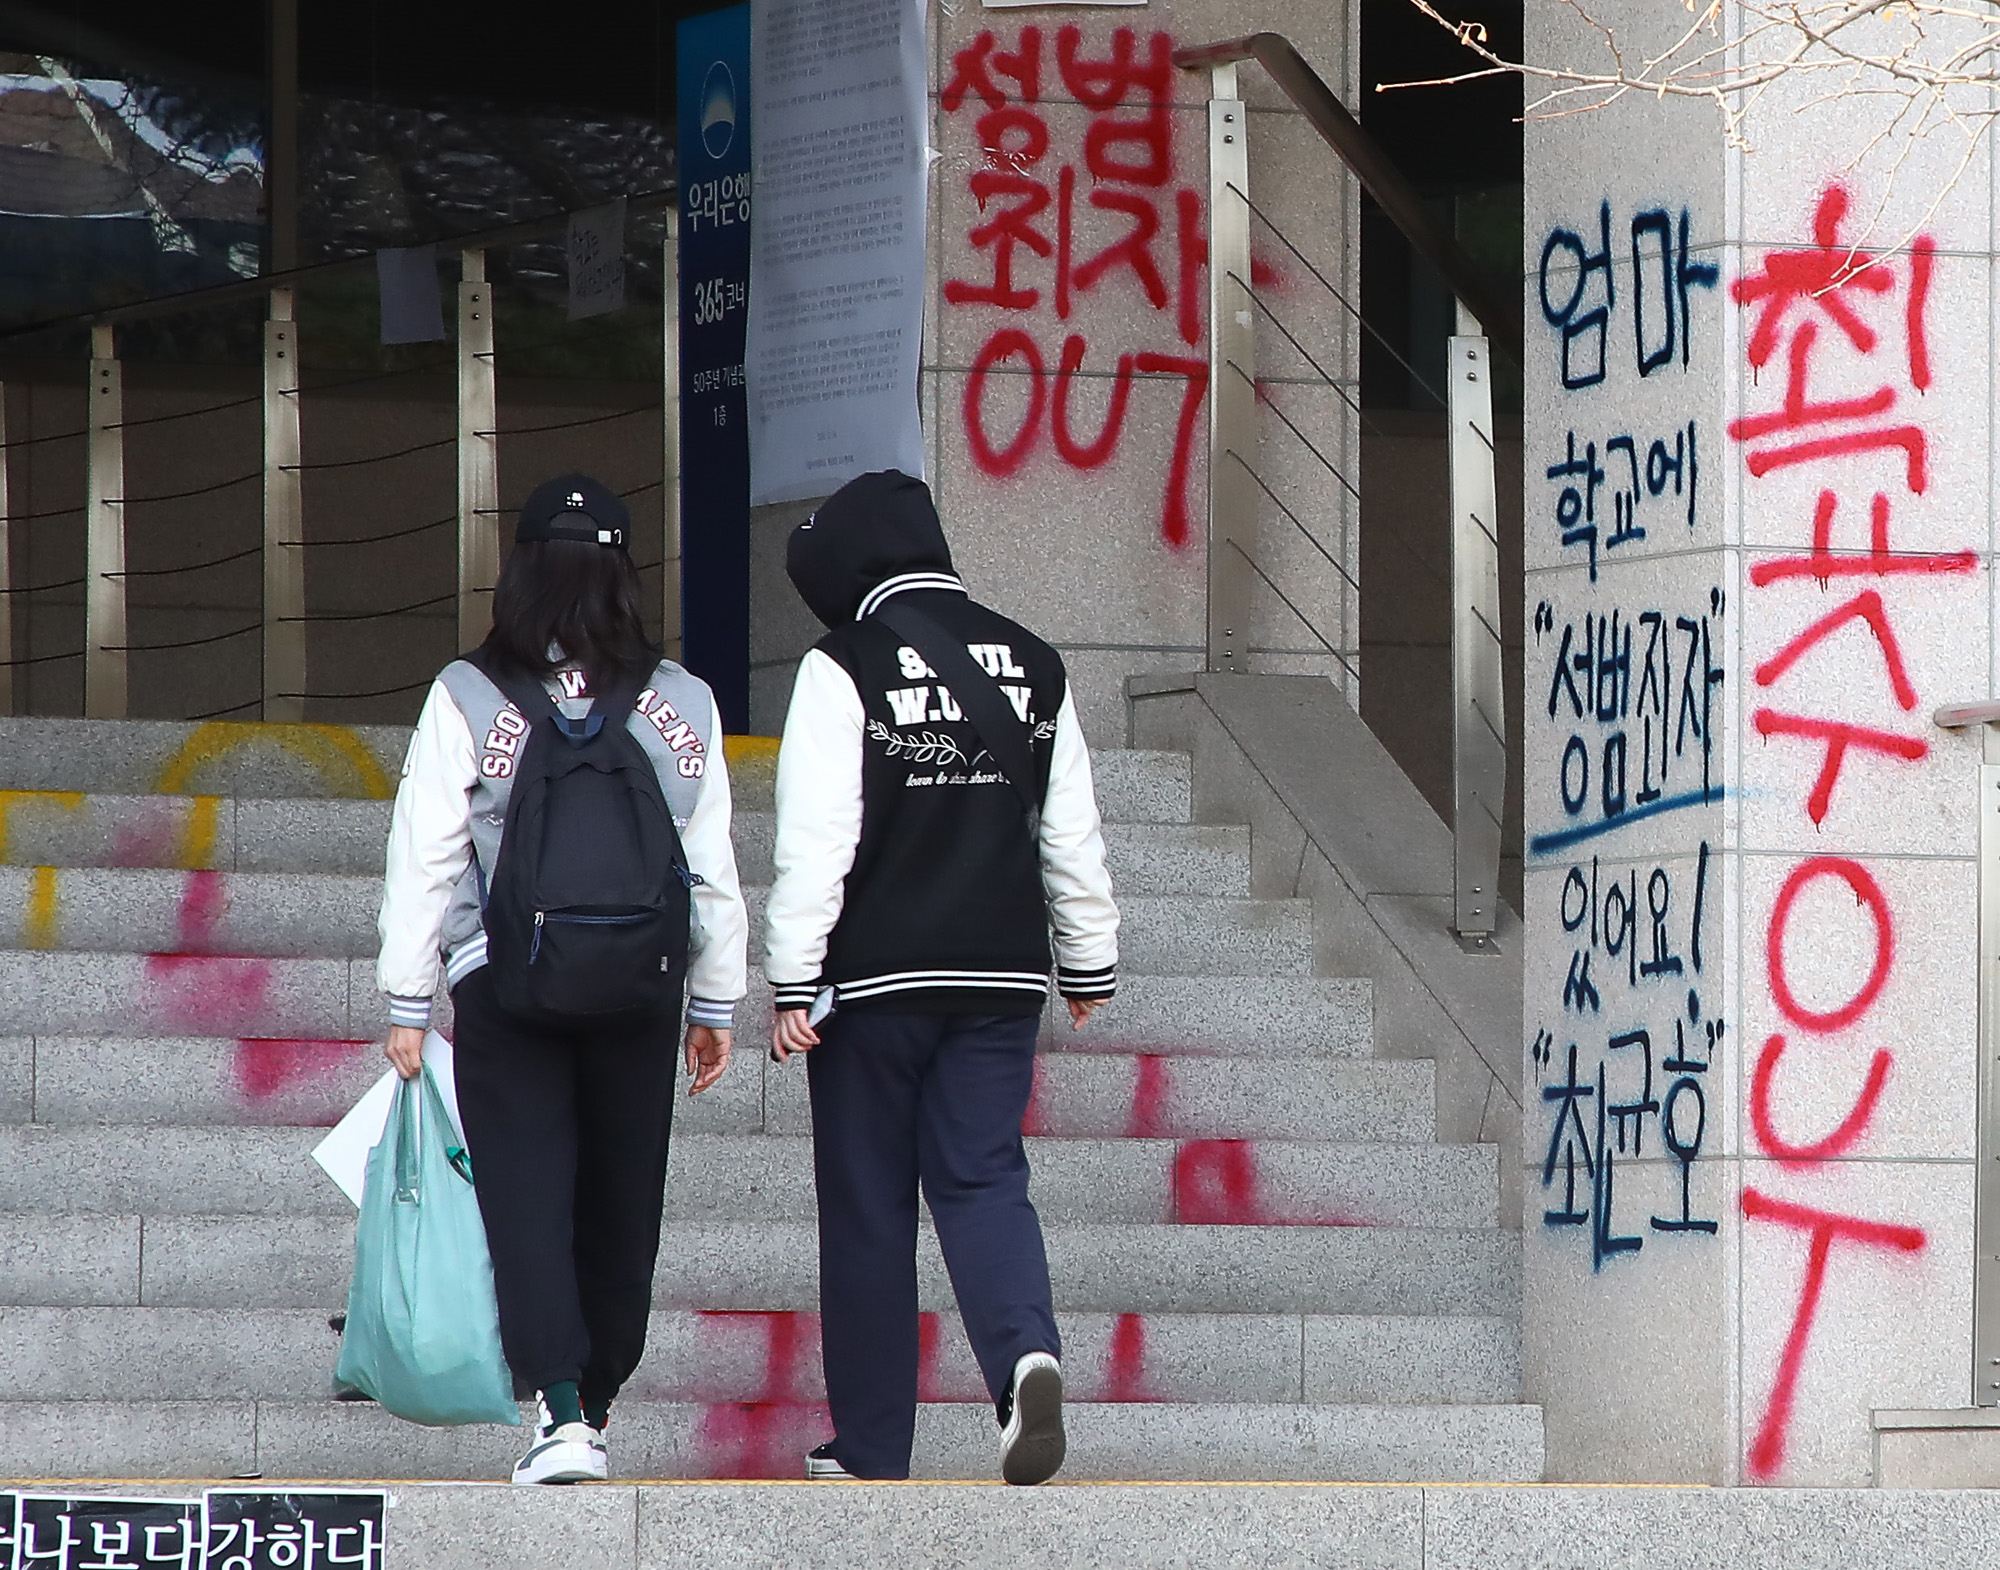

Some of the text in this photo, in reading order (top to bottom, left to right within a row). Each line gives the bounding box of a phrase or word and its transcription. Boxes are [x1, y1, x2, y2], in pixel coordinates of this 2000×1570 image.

[942, 26, 1172, 188] 성범
[687, 172, 750, 232] 우리은행
[944, 164, 1278, 347] 죄자
[694, 278, 724, 326] 365
[726, 281, 745, 311] 코너
[1540, 199, 1719, 390] 엄마
[693, 368, 720, 394] 50주년
[713, 405, 727, 427] 1층
[1546, 421, 1696, 582] 학교에
[897, 643, 1026, 680] SUL
[1728, 185, 1978, 1482] 최교수 OUT
[1560, 841, 1709, 1025] 있어요!
[207, 1517, 384, 1570] 강하다
